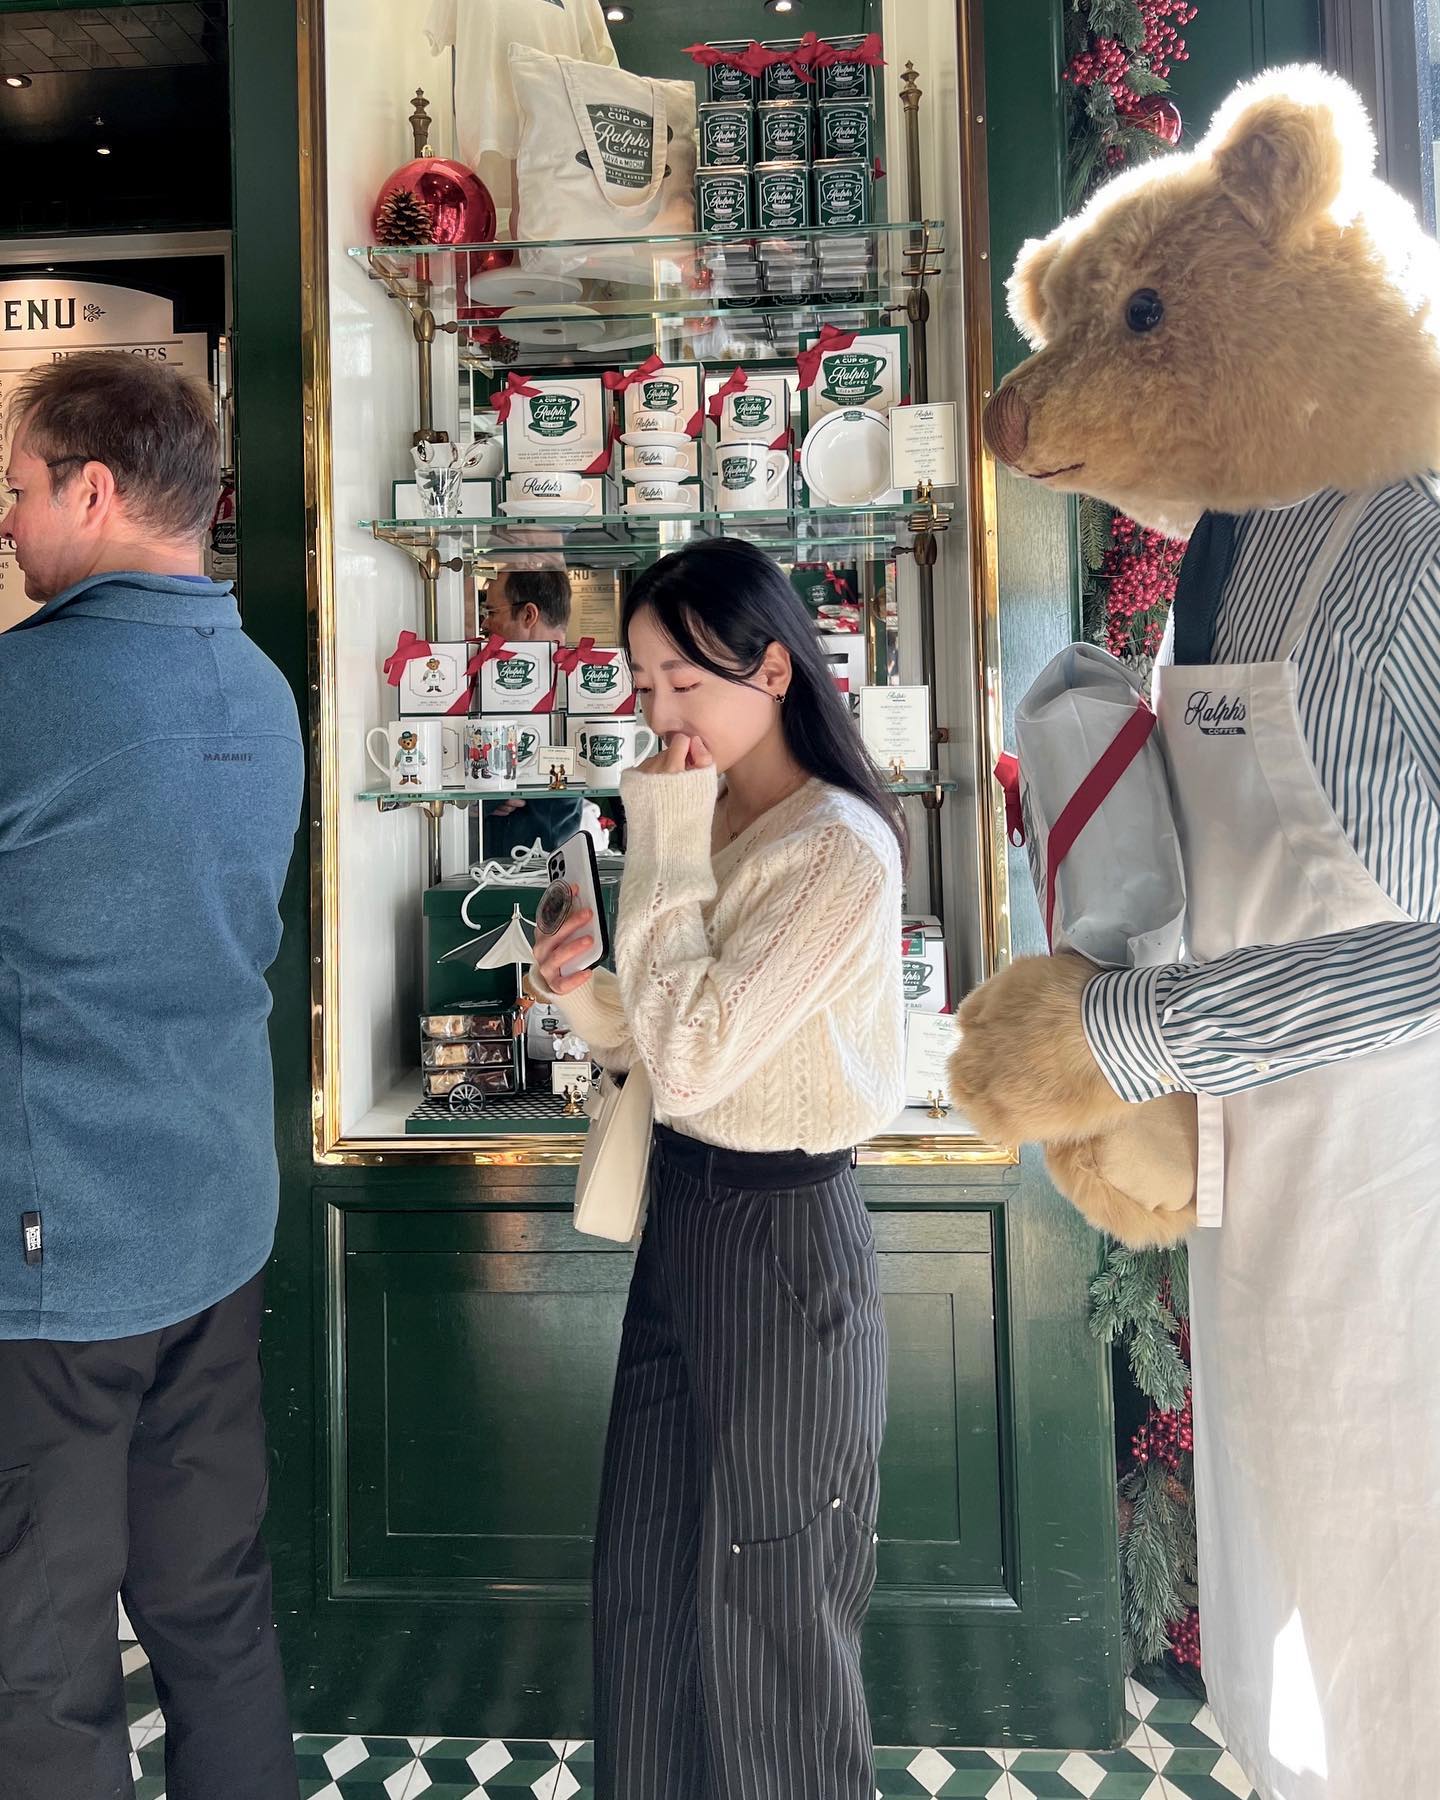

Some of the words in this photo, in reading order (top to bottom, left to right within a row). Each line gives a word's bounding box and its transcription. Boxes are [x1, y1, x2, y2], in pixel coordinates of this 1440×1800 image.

[608, 112, 630, 122] CUP
[633, 118, 648, 128] OF
[594, 122, 651, 155] Ralph's
[614, 146, 649, 158] COFFEE
[606, 169, 623, 178] ALPH
[4, 298, 76, 331] ENU
[828, 367, 869, 388] Ralph's
[534, 405, 567, 423] Ralph's
[522, 477, 562, 495] Ralph's
[1185, 691, 1246, 728] Ralph's
